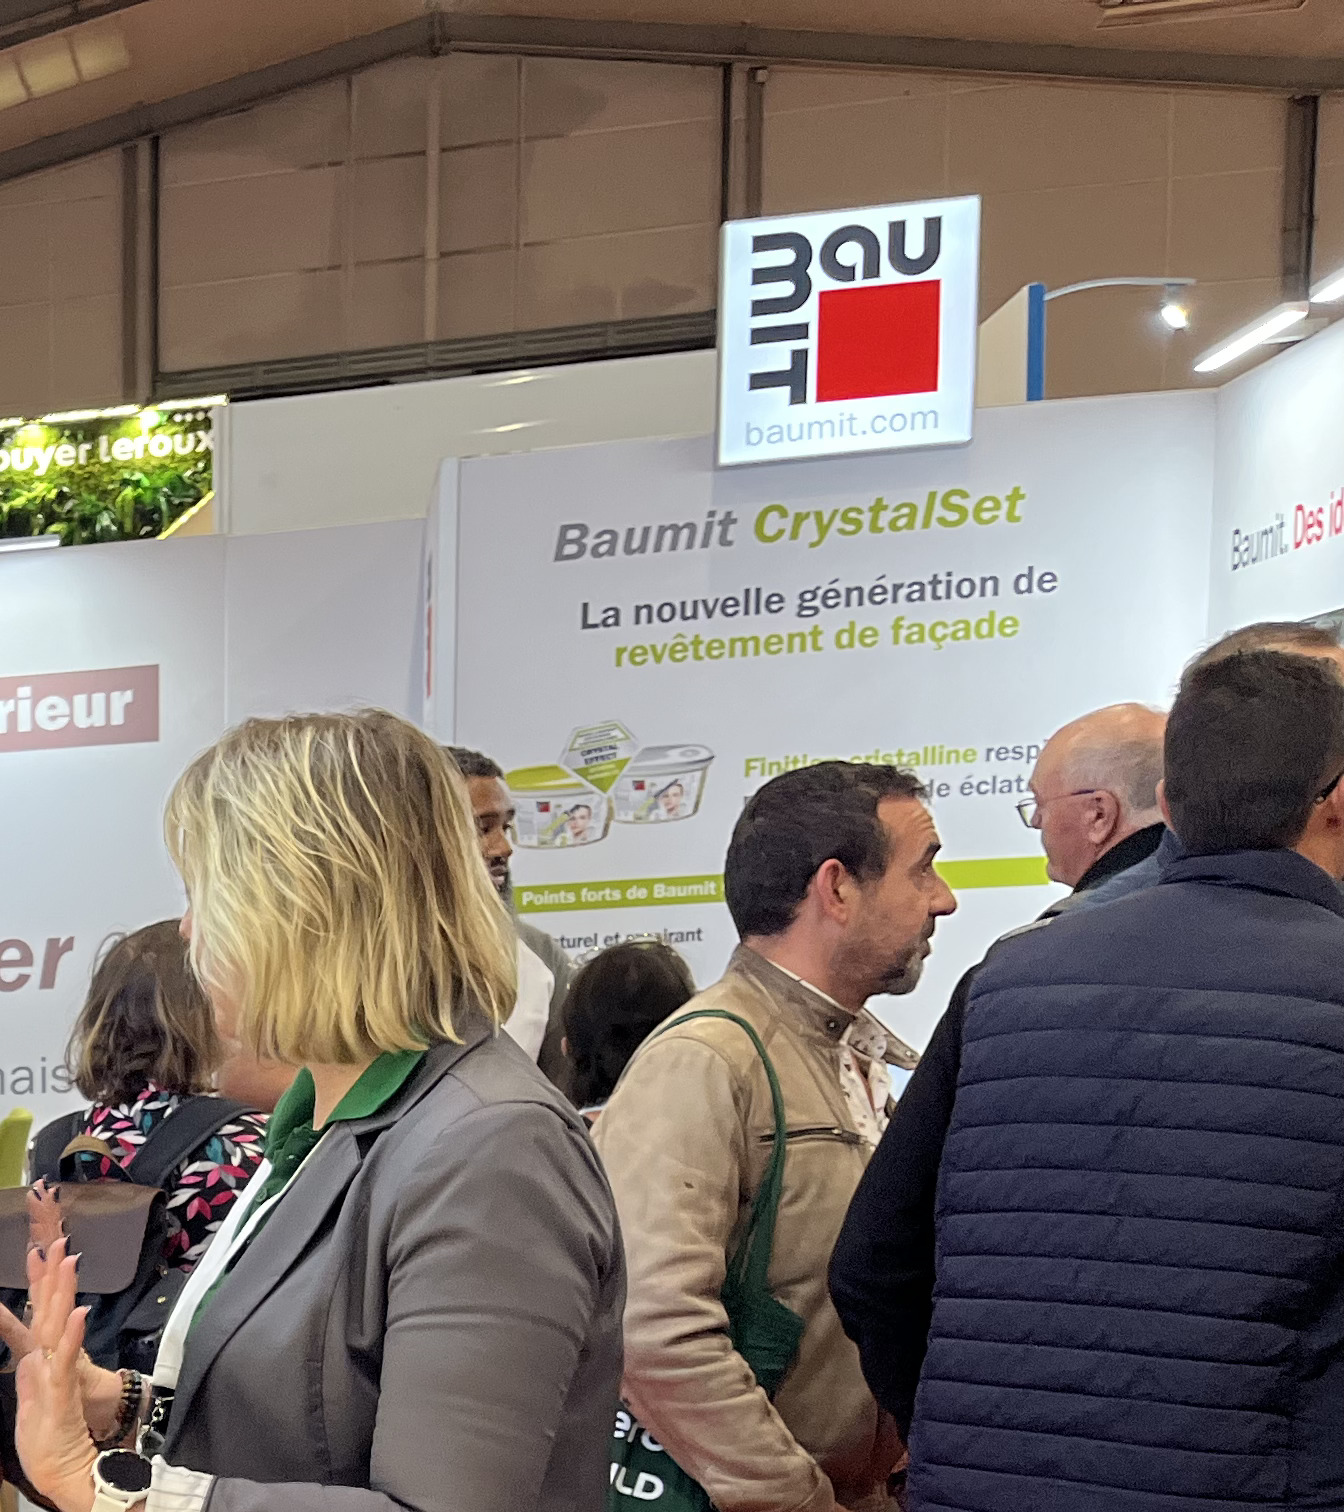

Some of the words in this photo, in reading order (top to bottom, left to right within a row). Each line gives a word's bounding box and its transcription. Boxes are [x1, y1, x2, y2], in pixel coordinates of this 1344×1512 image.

[745, 408, 940, 447] baumit.com
[99, 430, 215, 464] leroux
[553, 510, 738, 562] Baumit
[753, 486, 1026, 548] CrystalSet
[1294, 503, 1323, 550] Des
[580, 602, 622, 629] La
[633, 586, 786, 626] nouvelle
[796, 570, 1000, 618] génération
[1013, 566, 1058, 594] de
[614, 624, 824, 667] revêtement
[834, 620, 880, 648] de
[891, 610, 1020, 651] façade
[744, 752, 840, 778] Finiti
[985, 744, 1049, 764] resp
[959, 774, 1032, 797] éclat
[522, 890, 577, 906] Points
[581, 886, 622, 904] forts
[626, 884, 648, 901] de
[653, 880, 717, 899] Baumit
[552, 931, 599, 951] turel
